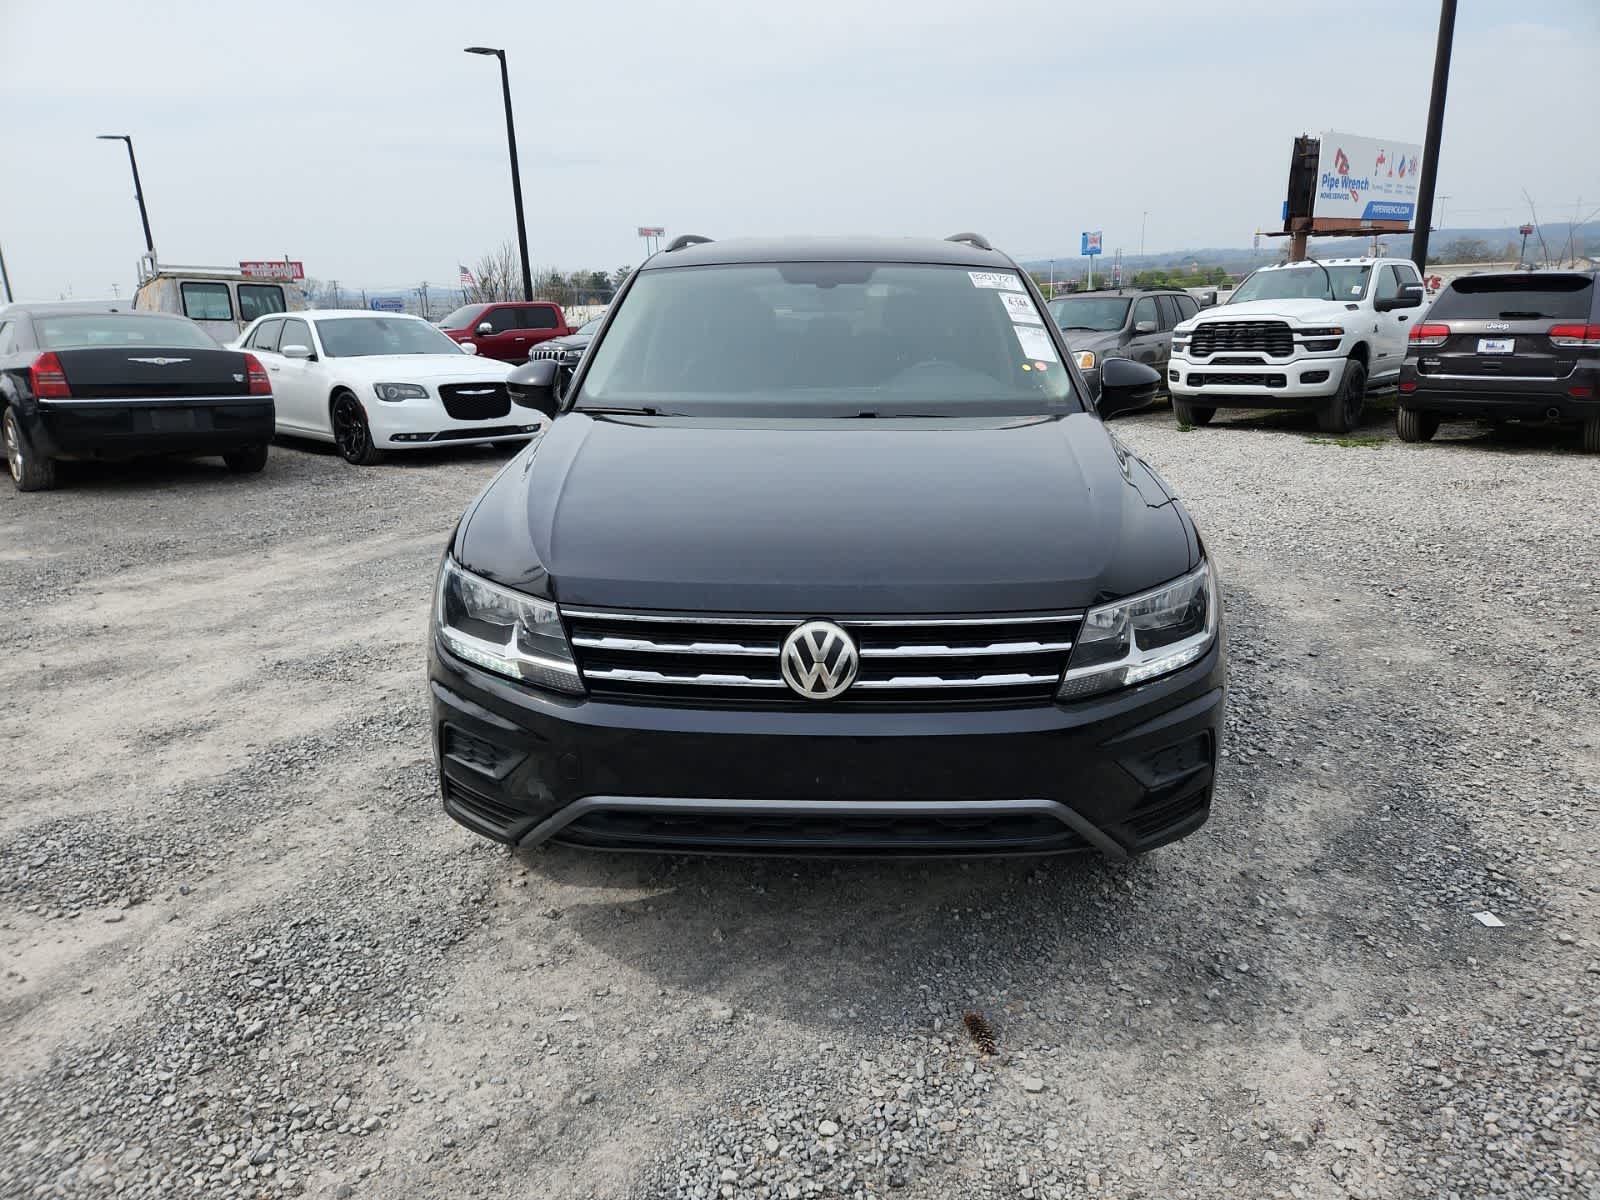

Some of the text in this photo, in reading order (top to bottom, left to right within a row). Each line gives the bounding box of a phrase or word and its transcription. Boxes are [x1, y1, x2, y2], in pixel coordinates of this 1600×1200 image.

[1321, 172, 1340, 190] Pipe
[1341, 175, 1369, 191] Wrench
[1485, 320, 1510, 331] Jeep
